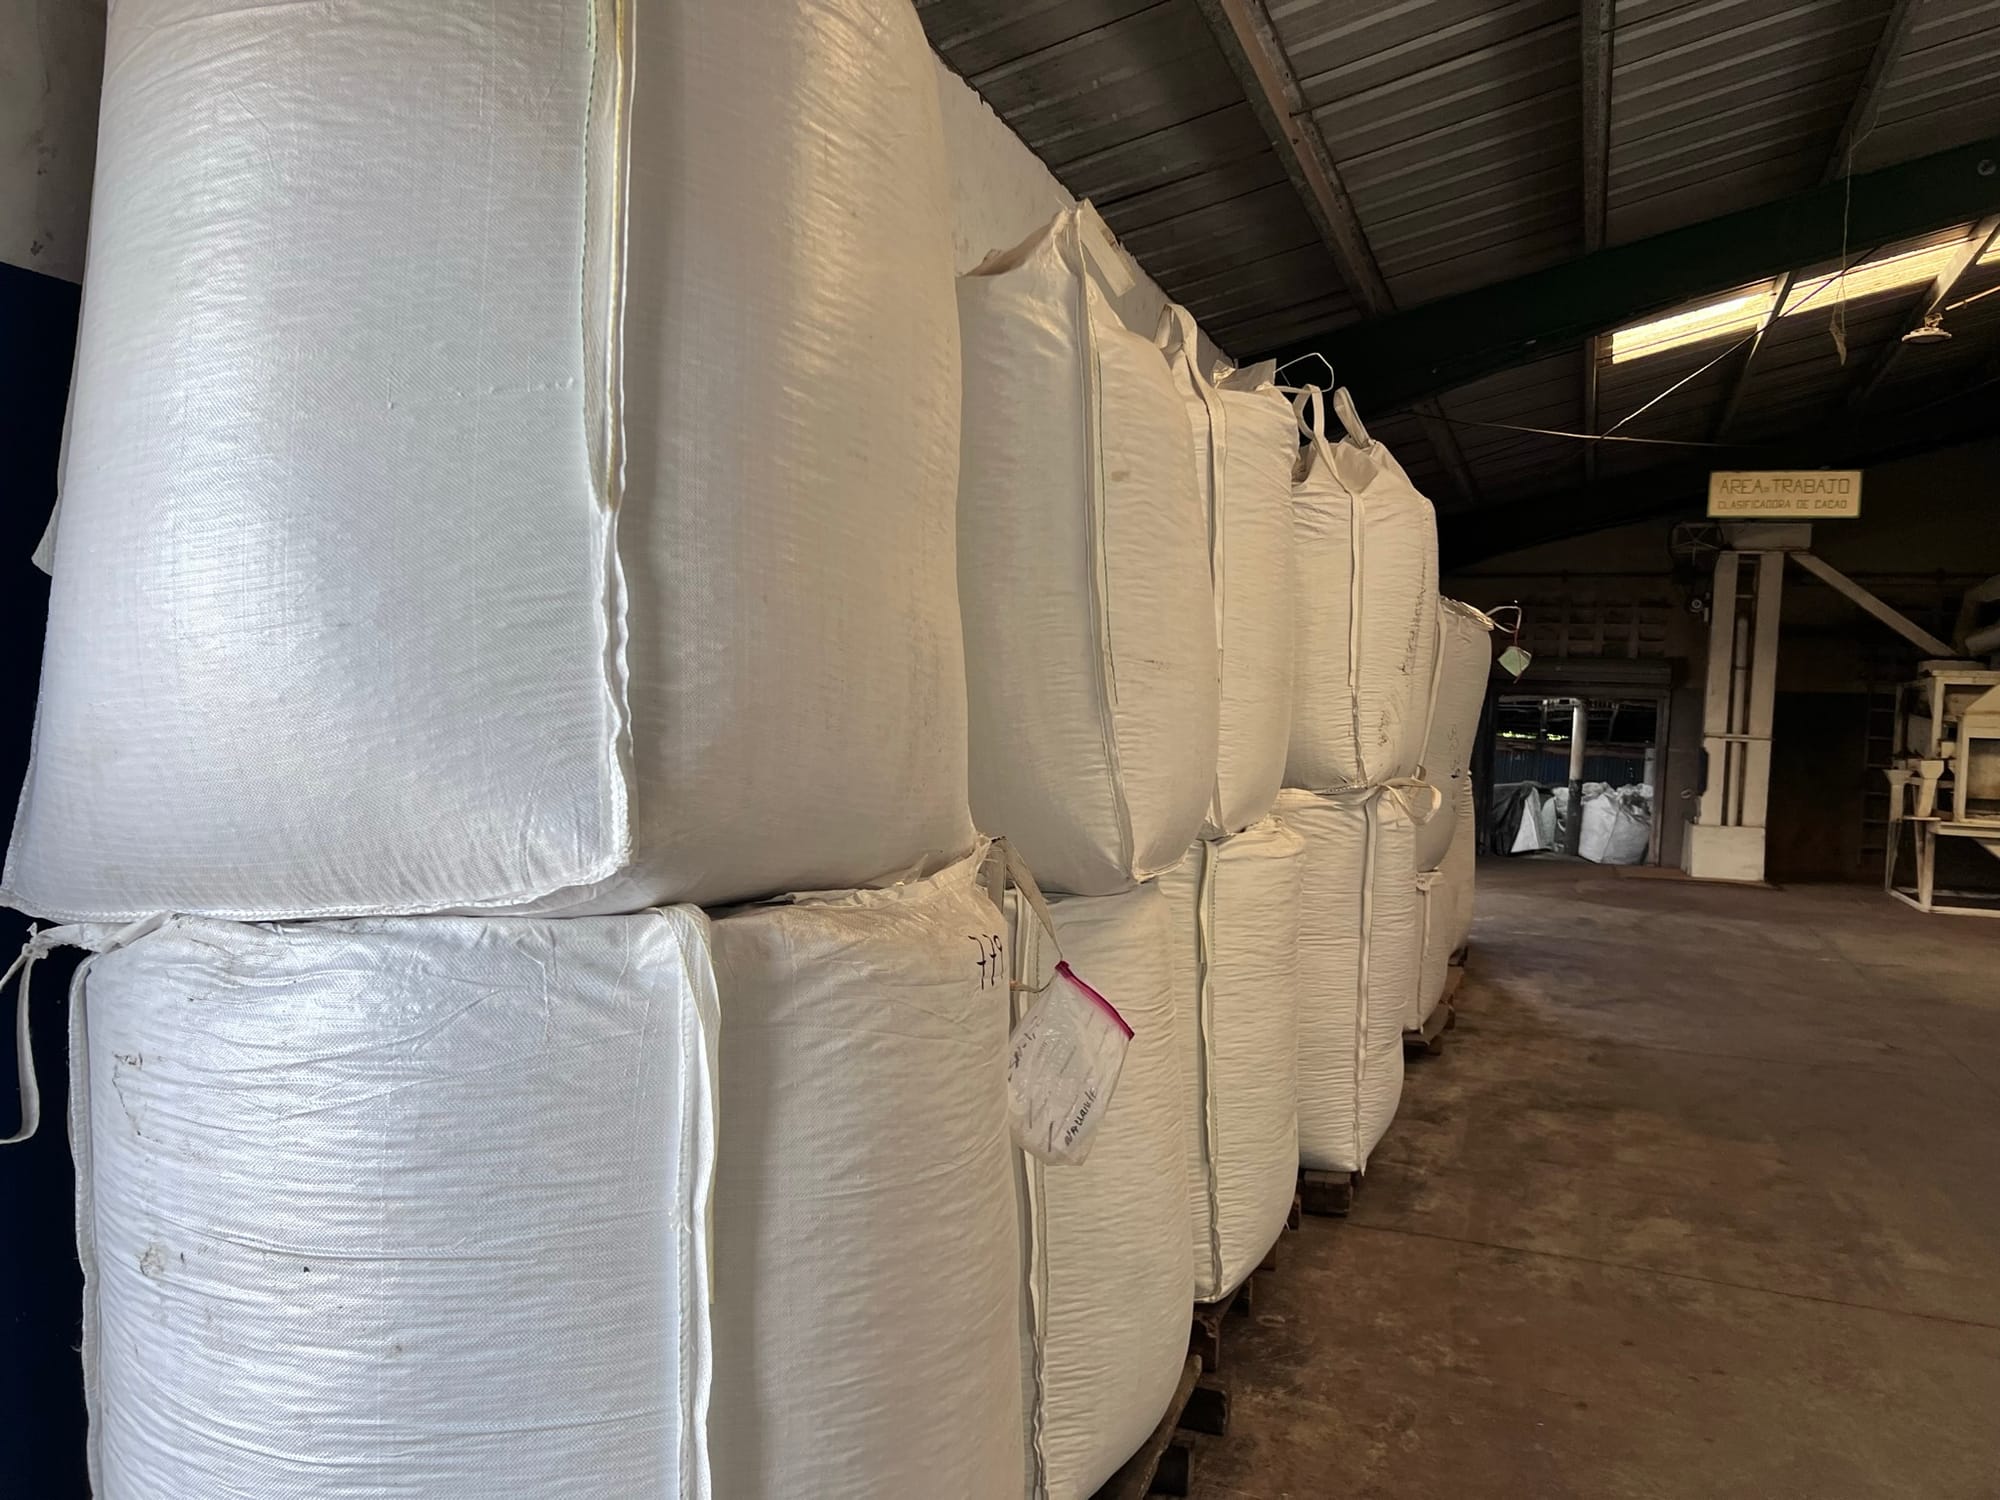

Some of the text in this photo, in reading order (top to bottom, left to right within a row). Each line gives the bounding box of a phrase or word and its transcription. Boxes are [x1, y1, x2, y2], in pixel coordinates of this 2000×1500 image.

[1719, 479, 1763, 494] AREA
[1772, 478, 1851, 494] TRABAJO
[1717, 500, 1848, 510] CLASIFICADORA DE CACAO
